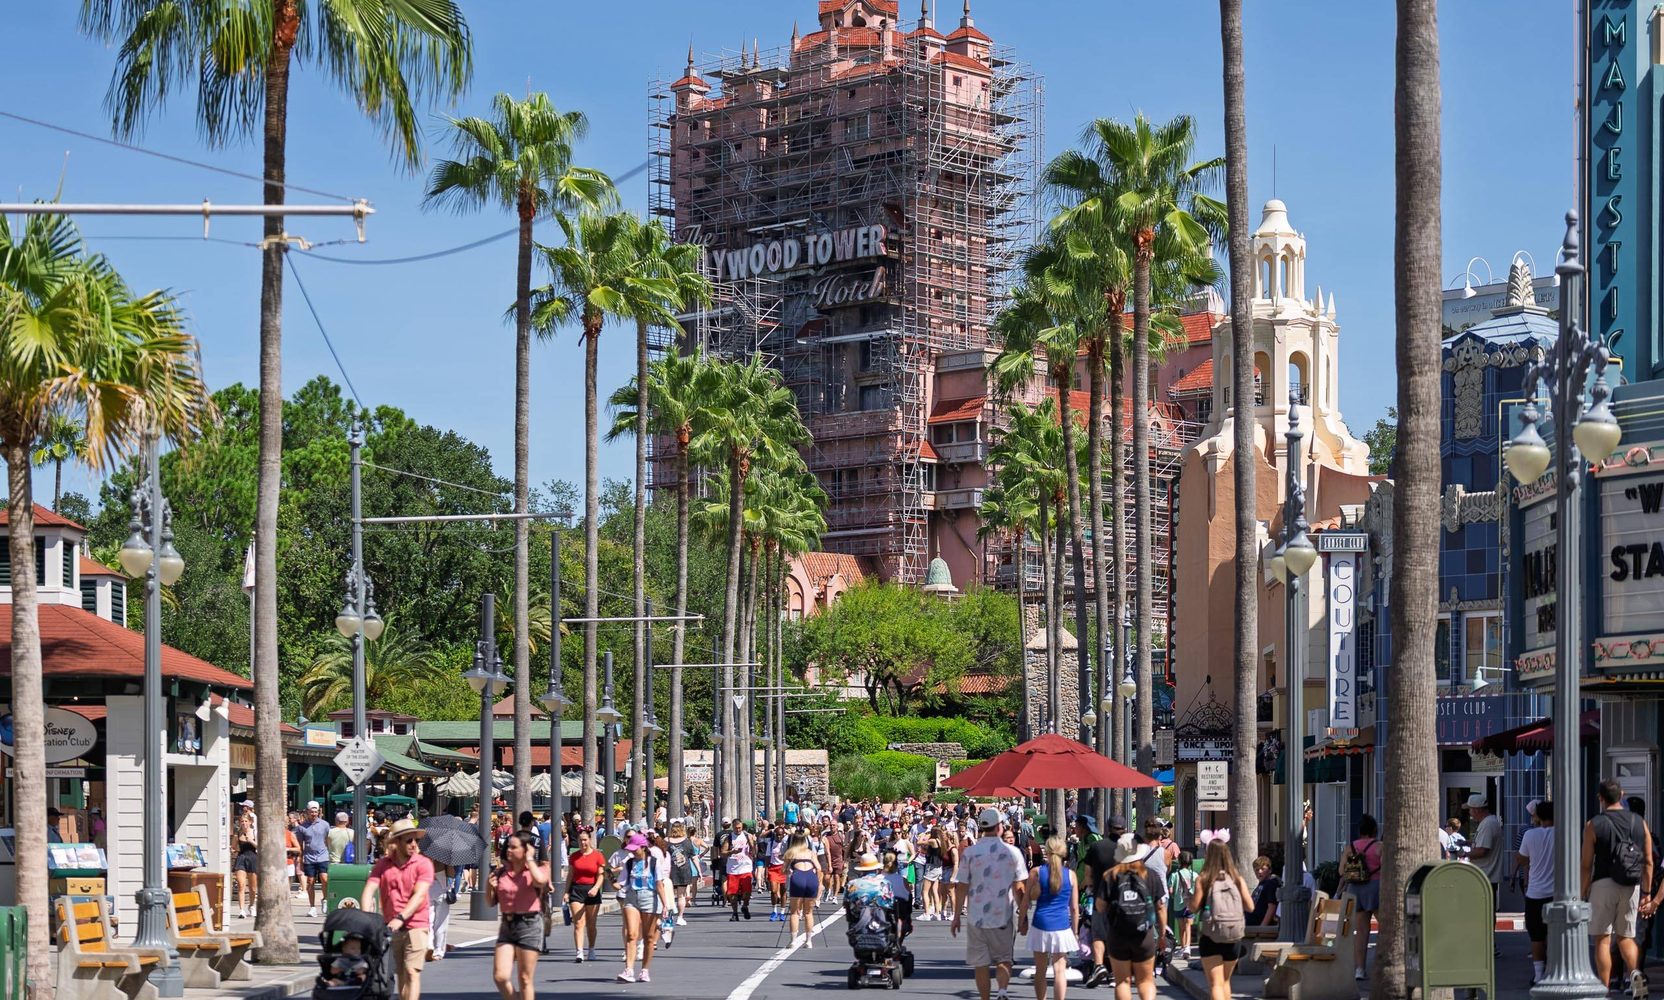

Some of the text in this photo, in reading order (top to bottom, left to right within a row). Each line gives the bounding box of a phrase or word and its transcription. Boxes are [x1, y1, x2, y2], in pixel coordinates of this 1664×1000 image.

[1603, 14, 1626, 359] MAJESTIC
[678, 224, 714, 247] The
[711, 224, 887, 281] YWOOD TOWER
[811, 266, 887, 309] Hotel
[1624, 482, 1664, 514] "W
[1610, 541, 1664, 582] STA
[1333, 560, 1352, 720] COUTURE
[1436, 701, 1486, 716] SET CLUB
[44, 737, 90, 747] cation Club
[1440, 720, 1494, 738] UTURE
[1184, 741, 1206, 749] ONCE
[1220, 749, 1234, 757] TIM
